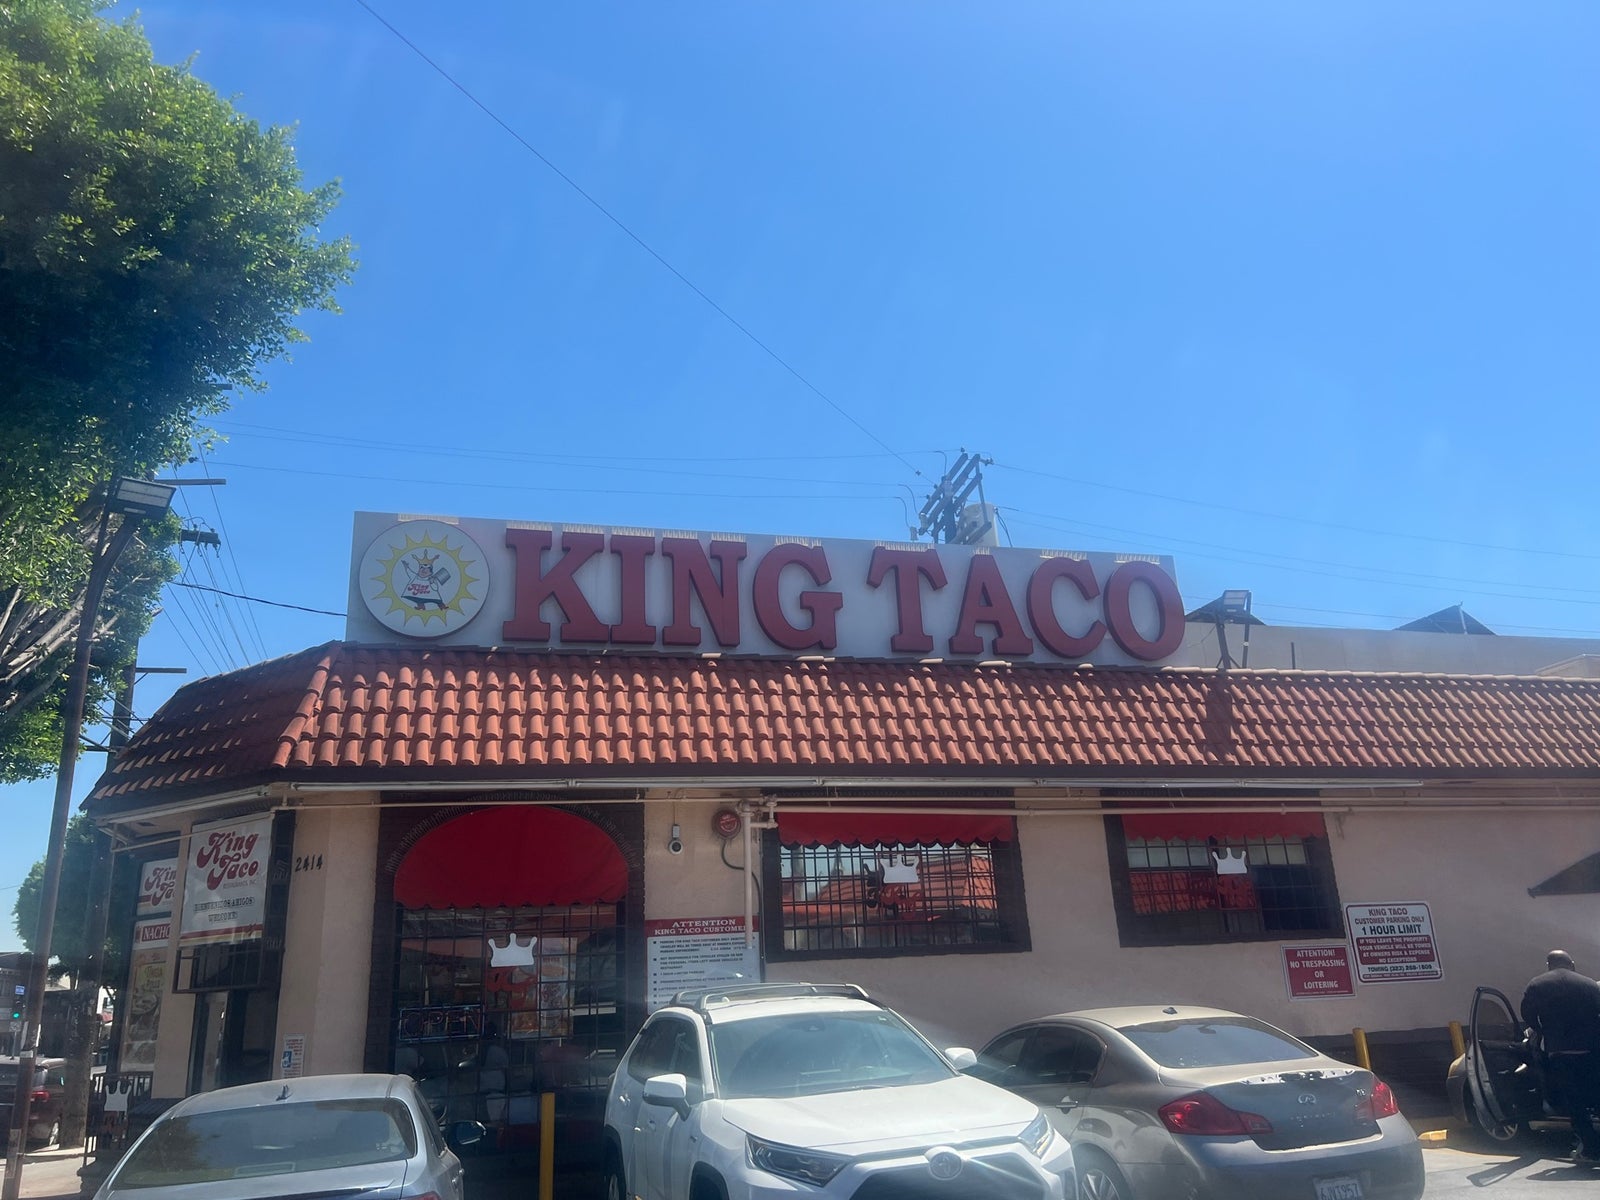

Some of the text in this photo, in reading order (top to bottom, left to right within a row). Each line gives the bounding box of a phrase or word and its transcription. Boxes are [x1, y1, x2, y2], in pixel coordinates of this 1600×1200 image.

[503, 528, 1186, 661] KING TACO
[197, 831, 259, 869] King
[295, 854, 323, 873] 2414
[207, 853, 259, 891] Taco
[145, 867, 177, 891] Kin
[1368, 907, 1408, 916] KING TACO
[672, 919, 736, 928] ATTENTION
[1355, 917, 1385, 925] CUSTOMER
[1386, 916, 1410, 924] PARKING
[143, 925, 171, 941] NACHO
[1362, 924, 1422, 935] 1 HOUR LIMIT
[1296, 949, 1336, 957] ATTENTION!
[1301, 959, 1346, 968] TRESPASSING
[1314, 970, 1325, 978] OR
[1303, 981, 1339, 989] LOITERING
